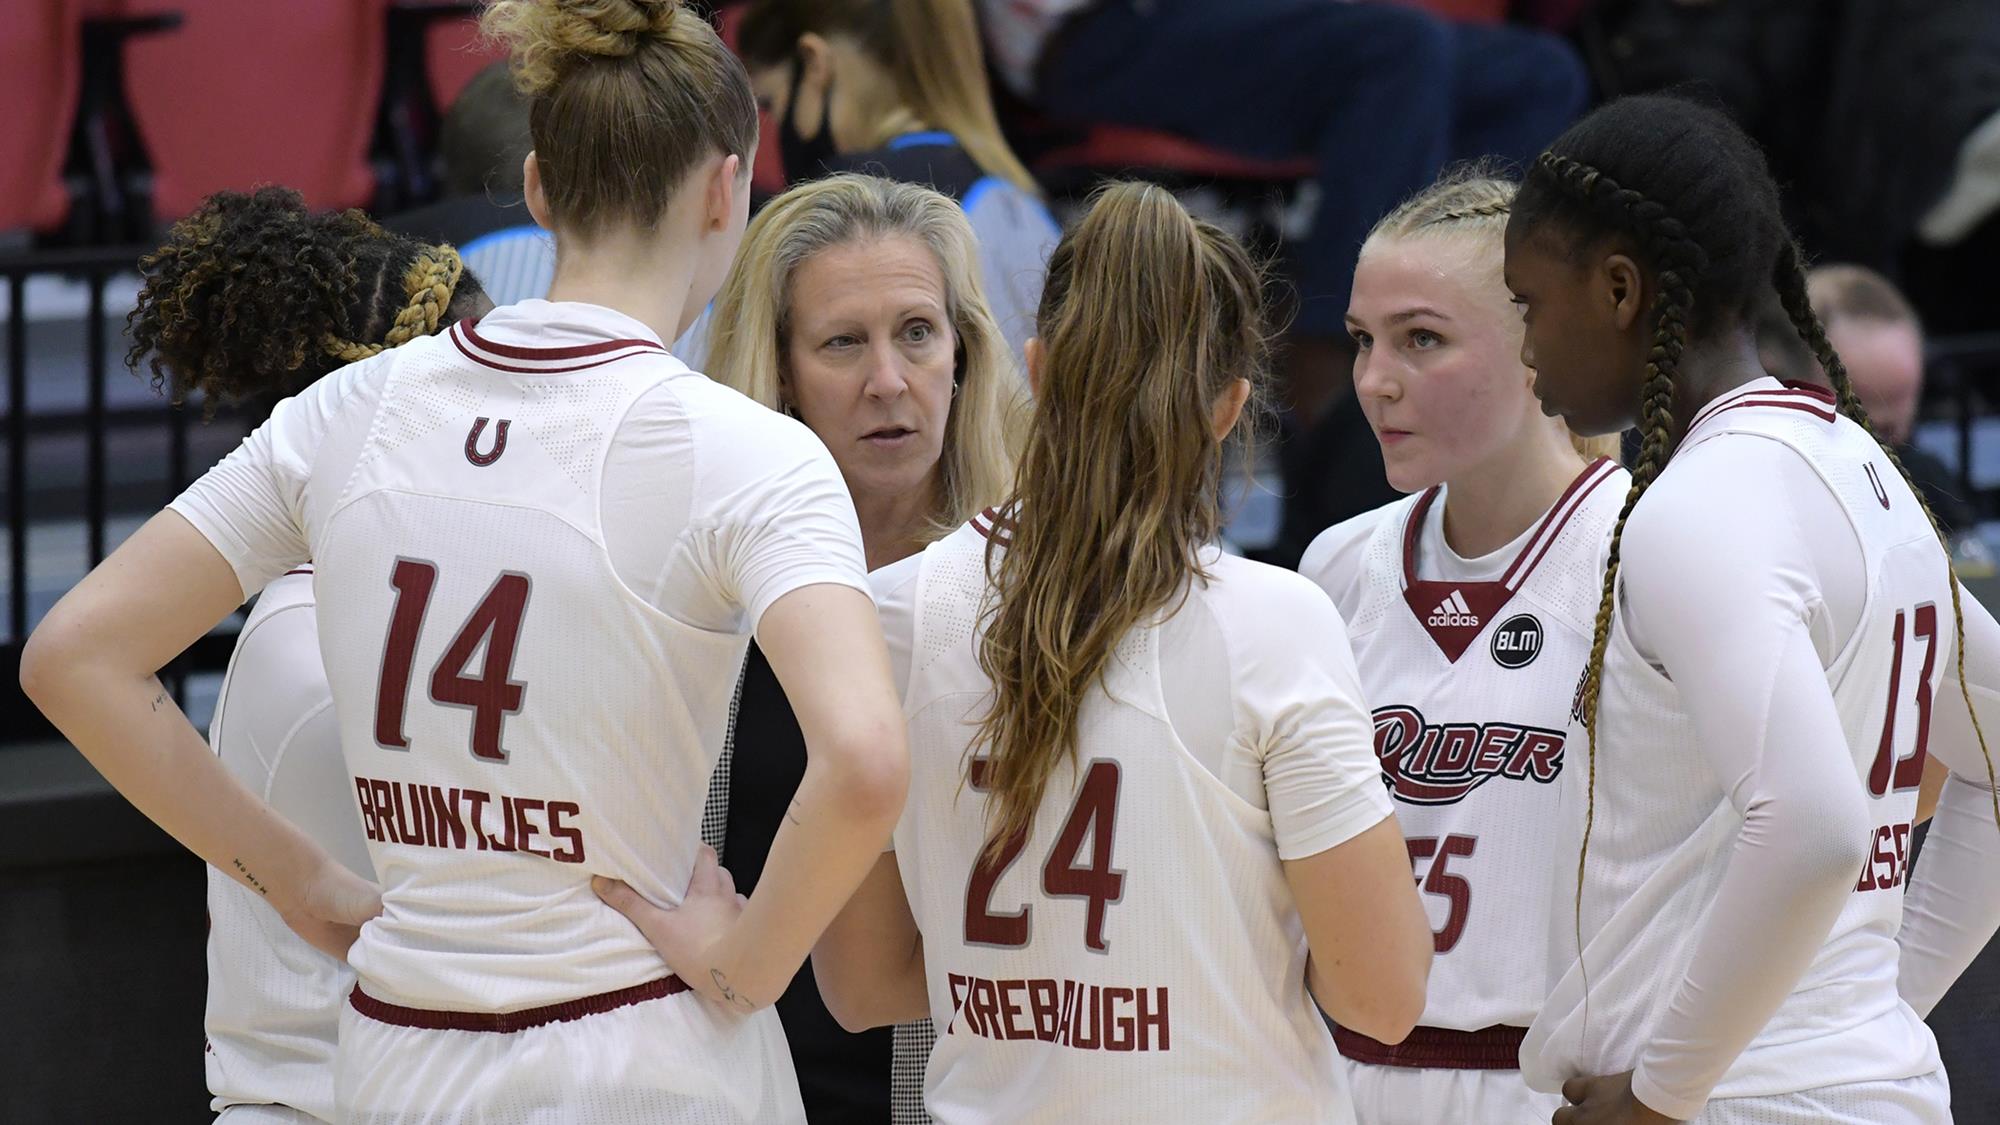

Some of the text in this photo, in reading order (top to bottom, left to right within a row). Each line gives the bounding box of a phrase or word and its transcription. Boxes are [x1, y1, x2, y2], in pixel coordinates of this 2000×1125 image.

[374, 555, 532, 765] 14
[1428, 613, 1479, 627] adidas
[1496, 630, 1538, 651] BLM
[1866, 600, 1938, 800] 13
[354, 776, 585, 864] BRUINTJES
[963, 755, 1128, 955] 24
[948, 972, 1170, 1052] FIREBAUGH
